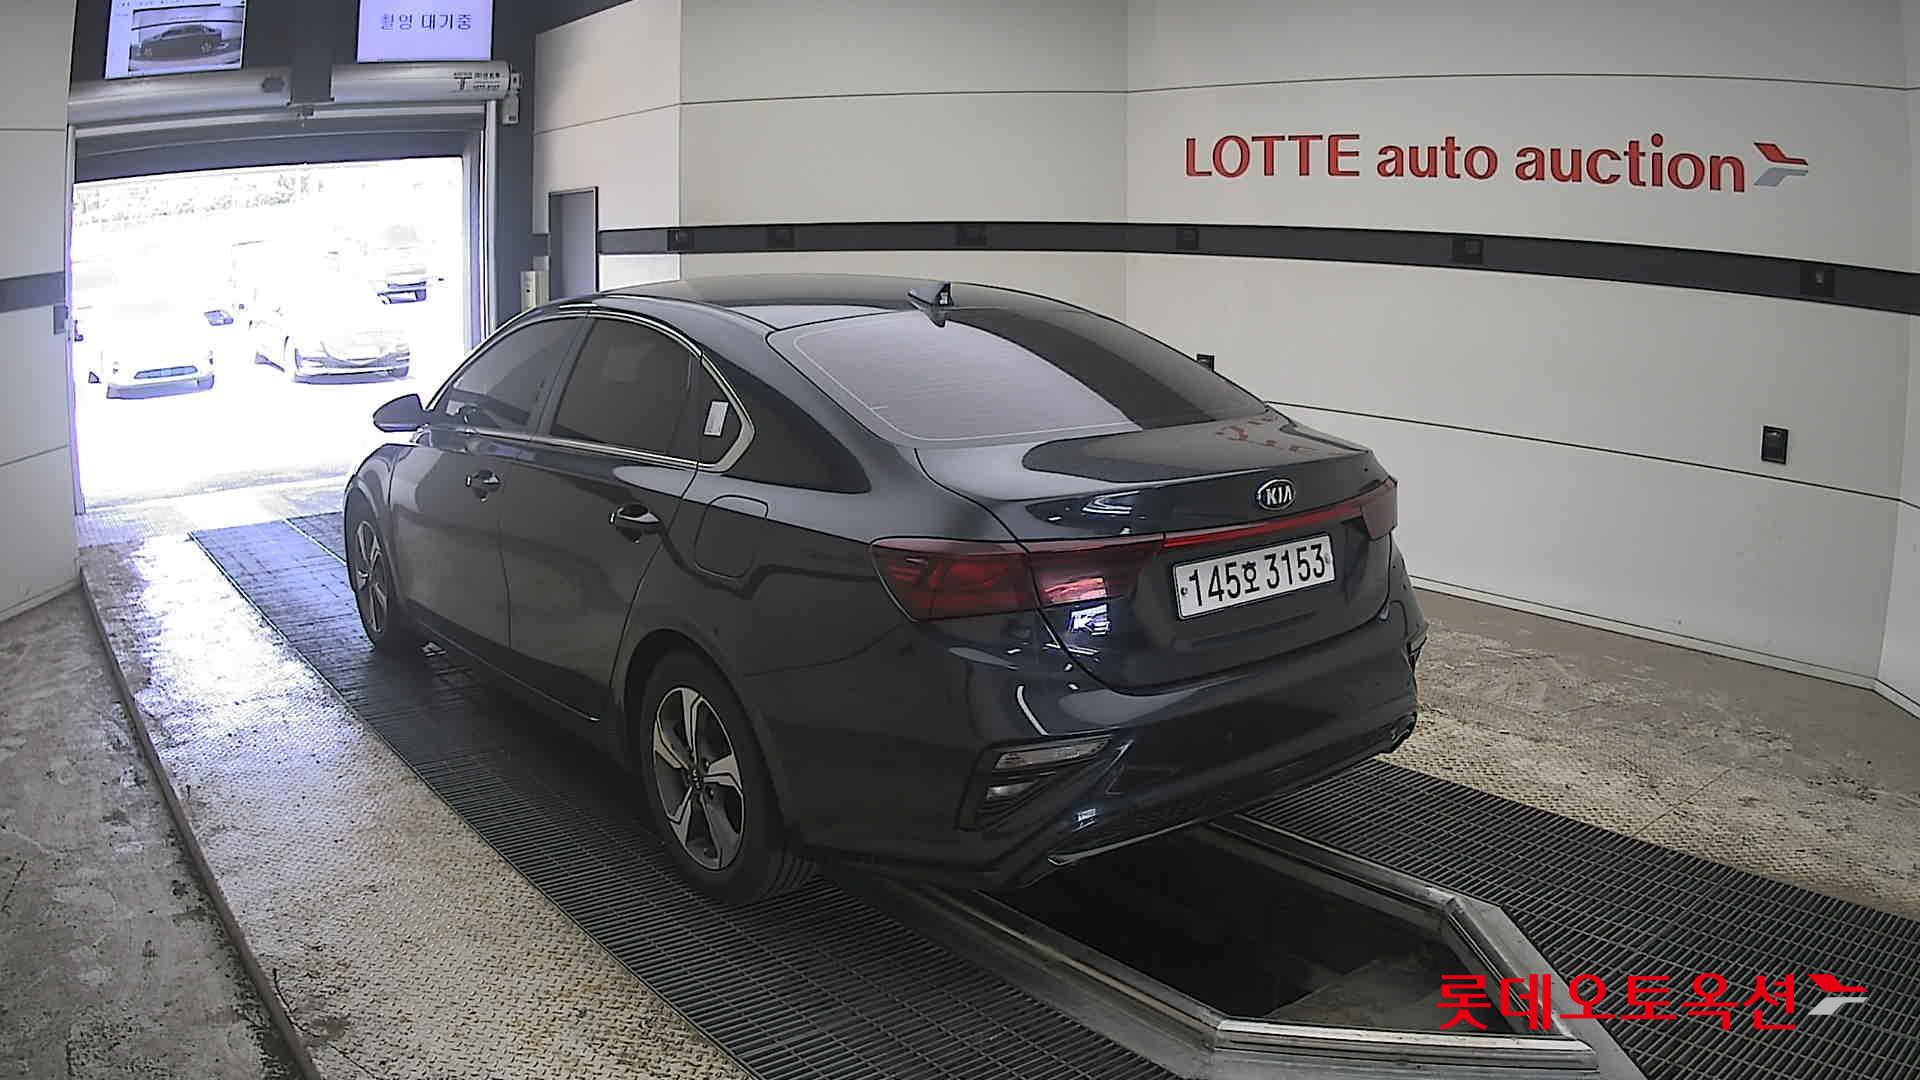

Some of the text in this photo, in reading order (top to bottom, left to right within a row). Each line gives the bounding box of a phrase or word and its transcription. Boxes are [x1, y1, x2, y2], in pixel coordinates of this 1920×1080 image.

[421, 13, 473, 31] 대기중
[1185, 133, 1745, 193] LOTTE auto auction
